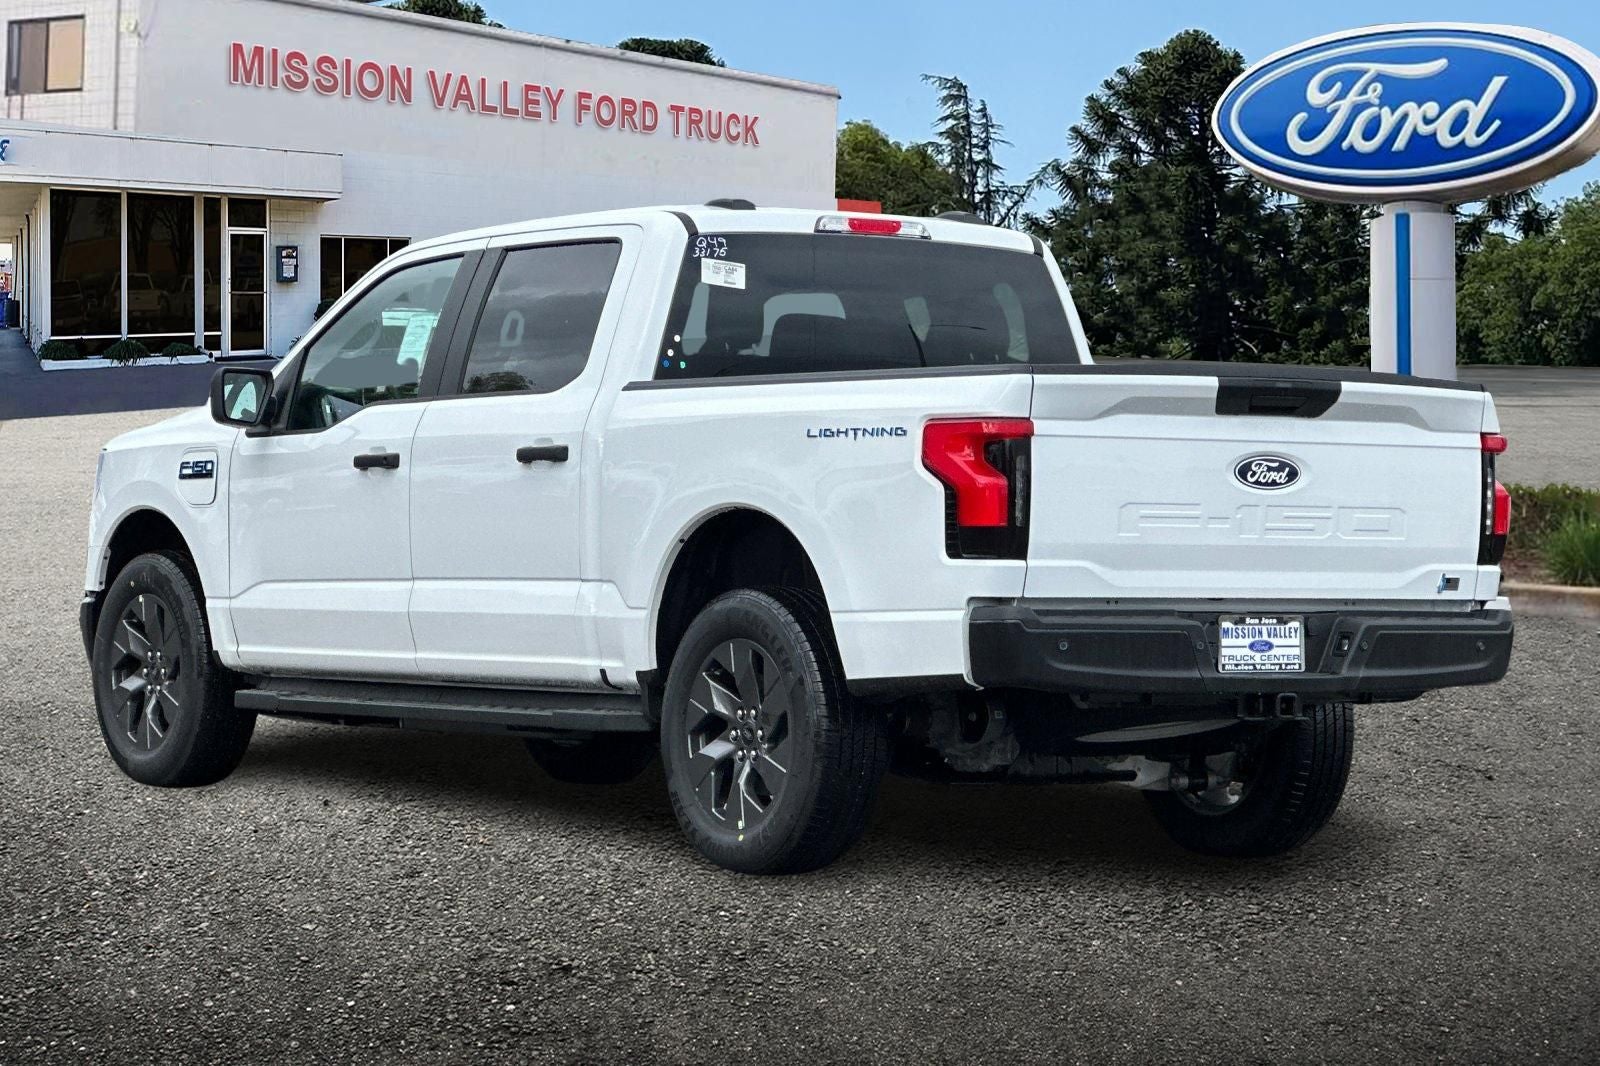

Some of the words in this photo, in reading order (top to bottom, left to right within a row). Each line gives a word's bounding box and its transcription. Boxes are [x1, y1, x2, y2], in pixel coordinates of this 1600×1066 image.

[229, 41, 414, 105] MISSION
[427, 69, 565, 122] VALLEY
[575, 90, 659, 134] FORD
[669, 103, 761, 146] TRUCK
[1286, 57, 1509, 156] Ford
[806, 426, 908, 441] LIGHTNING
[1246, 459, 1289, 485] Ford
[1118, 501, 1408, 541] F-150
[1222, 626, 1263, 639] MISSION
[1266, 626, 1299, 639] VALLEY
[1222, 654, 1256, 662] TRUCK
[1260, 654, 1300, 662] CENTER
[1256, 663, 1280, 671] Valley
